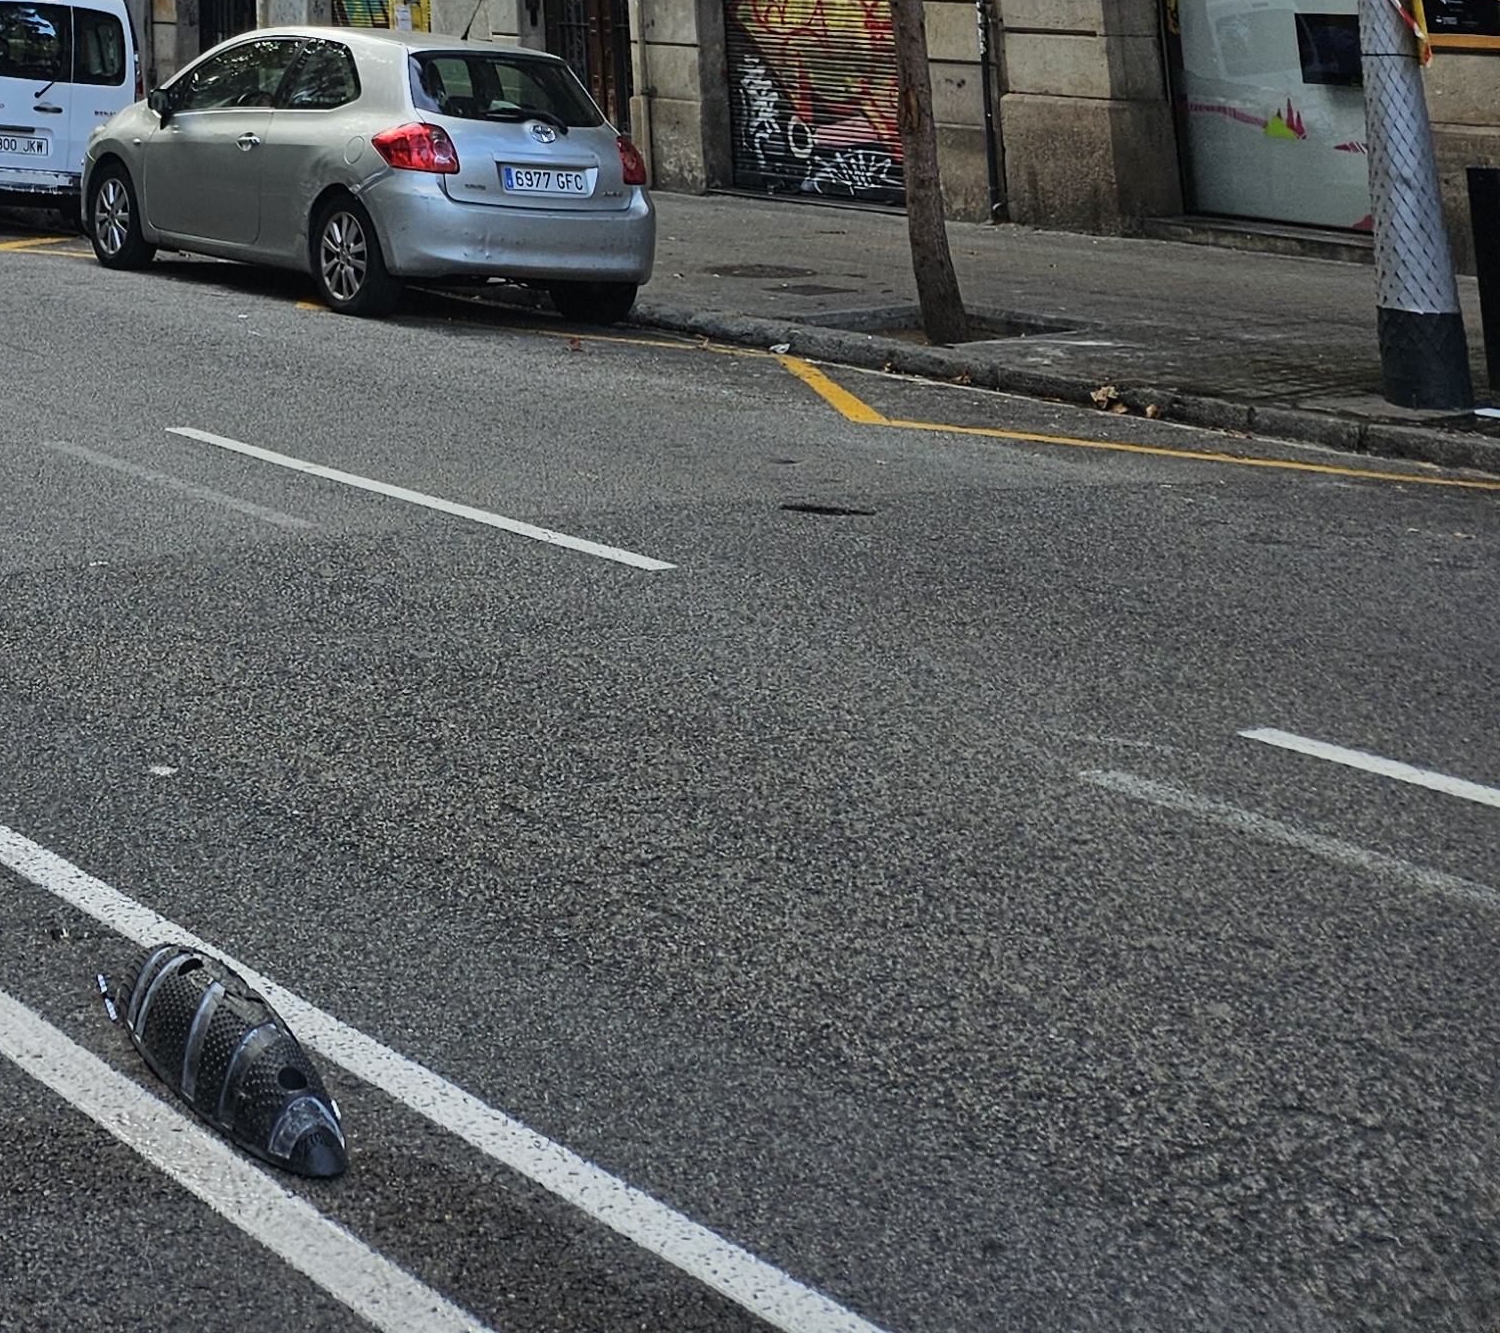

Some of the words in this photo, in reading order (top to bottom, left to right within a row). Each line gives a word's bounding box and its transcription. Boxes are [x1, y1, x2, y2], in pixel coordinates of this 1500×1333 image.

[22, 141, 44, 154] JKW
[515, 170, 550, 189] 6977
[556, 173, 584, 191] GFC
